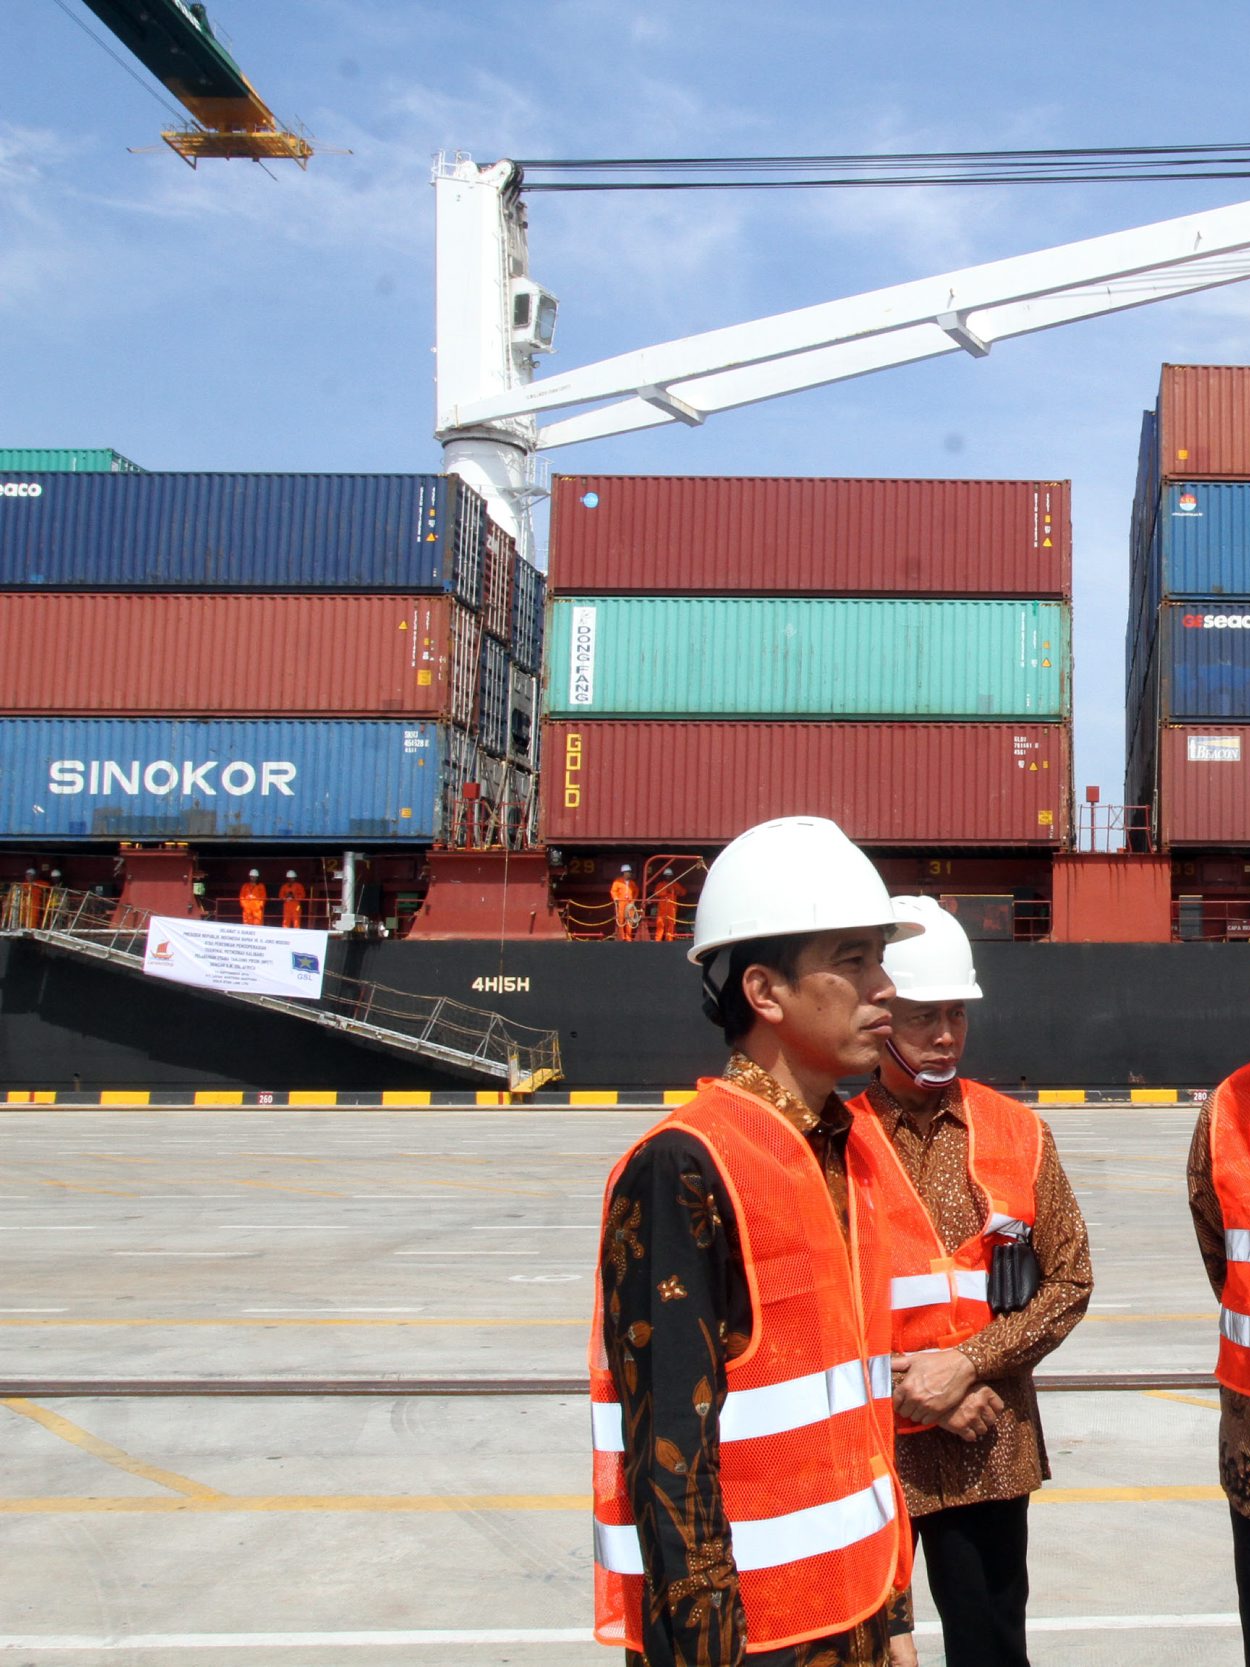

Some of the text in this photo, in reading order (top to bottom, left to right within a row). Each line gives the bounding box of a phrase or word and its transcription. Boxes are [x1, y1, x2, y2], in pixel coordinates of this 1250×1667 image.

[565, 734, 582, 808] GOLD
[49, 760, 297, 796] SINOKOR
[930, 861, 952, 874] 31
[259, 1095, 272, 1104] 260
[1194, 1092, 1207, 1100] 280
